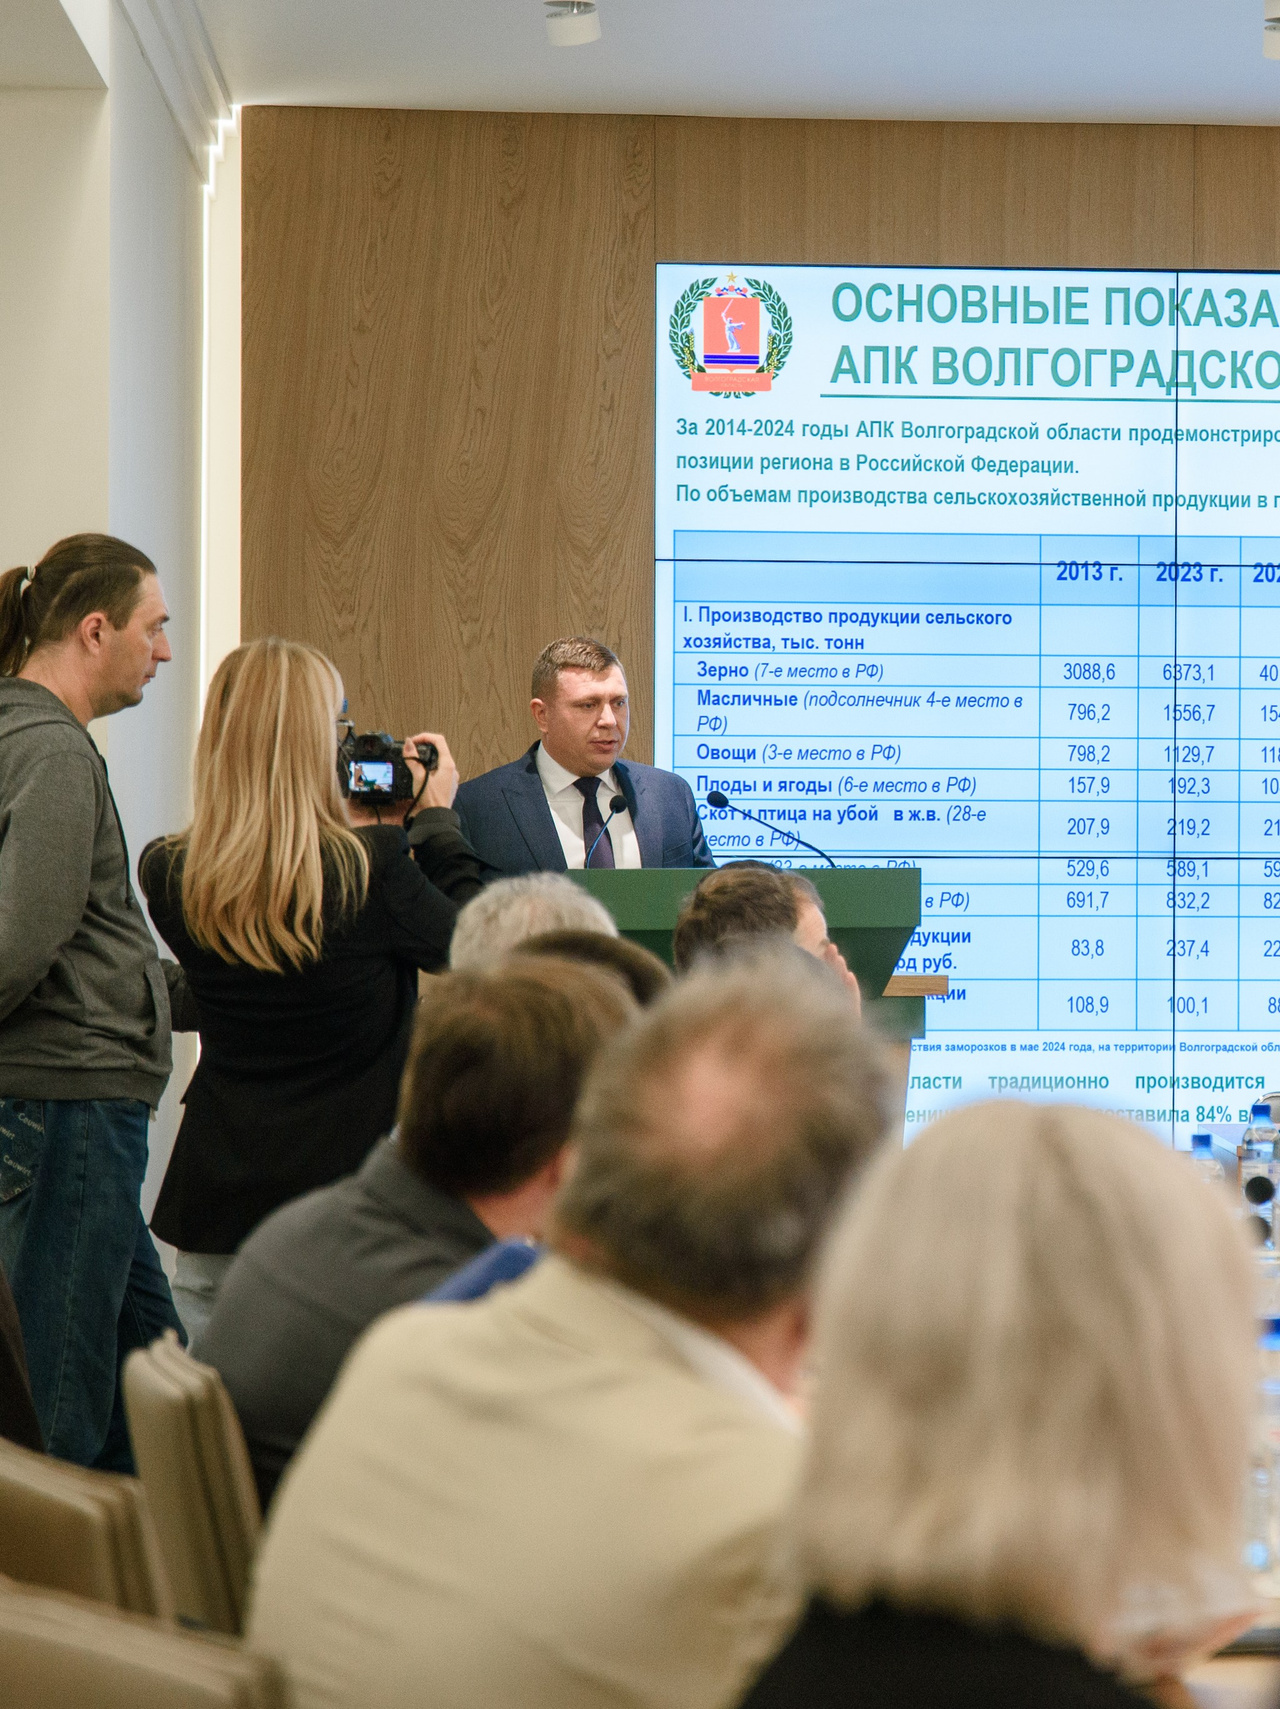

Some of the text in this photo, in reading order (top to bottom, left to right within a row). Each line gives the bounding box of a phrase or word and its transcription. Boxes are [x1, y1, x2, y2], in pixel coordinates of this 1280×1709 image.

[831, 283, 1090, 324] ОСНОВНЫЕ
[829, 345, 918, 387] АПК
[676, 417, 699, 435] За
[704, 418, 796, 436] 2014-2024
[801, 423, 849, 440] годы
[855, 420, 895, 438] АПК
[901, 421, 1040, 444] Волгоградской
[1046, 422, 1122, 440] области
[676, 454, 1079, 477] позиции региона в Российской Федерации.
[676, 484, 701, 502] По
[706, 483, 792, 502] объемам
[797, 489, 928, 508] производства
[933, 487, 1147, 506] сельскохозяйственной
[1152, 493, 1251, 512] продукции
[1257, 494, 1268, 508] в
[1056, 560, 1124, 581] 2013 г.
[683, 605, 1013, 628] I. Производство продукции сельского
[682, 631, 865, 652] хозяйства, тыс. тонн
[697, 661, 884, 682] Зерно (7-е место в РФ)
[1063, 662, 1116, 683] 3088,6
[697, 689, 1023, 710] Масличные (подсолнечник 4-е место в
[1067, 702, 1111, 723] 796,2
[697, 715, 728, 736] РФ)
[697, 775, 977, 796] Плоды и ягоды (6-е место в РФ)
[1068, 776, 1111, 797] 157,9
[1066, 817, 1110, 838] 207,9
[910, 1038, 942, 1051] ствия
[944, 1043, 1008, 1053] заморозков
[1010, 1043, 1017, 1051] в
[1019, 1043, 1040, 1051] мае
[1042, 1040, 1066, 1051] 2024
[1068, 1043, 1095, 1052] года,
[1098, 1043, 1111, 1051] на
[1113, 1043, 1177, 1053] территории
[1179, 1042, 1258, 1054] Волгоградской
[909, 1075, 962, 1090] ласти
[988, 1075, 1110, 1093] традиционно
[1135, 1075, 1265, 1093] производится
